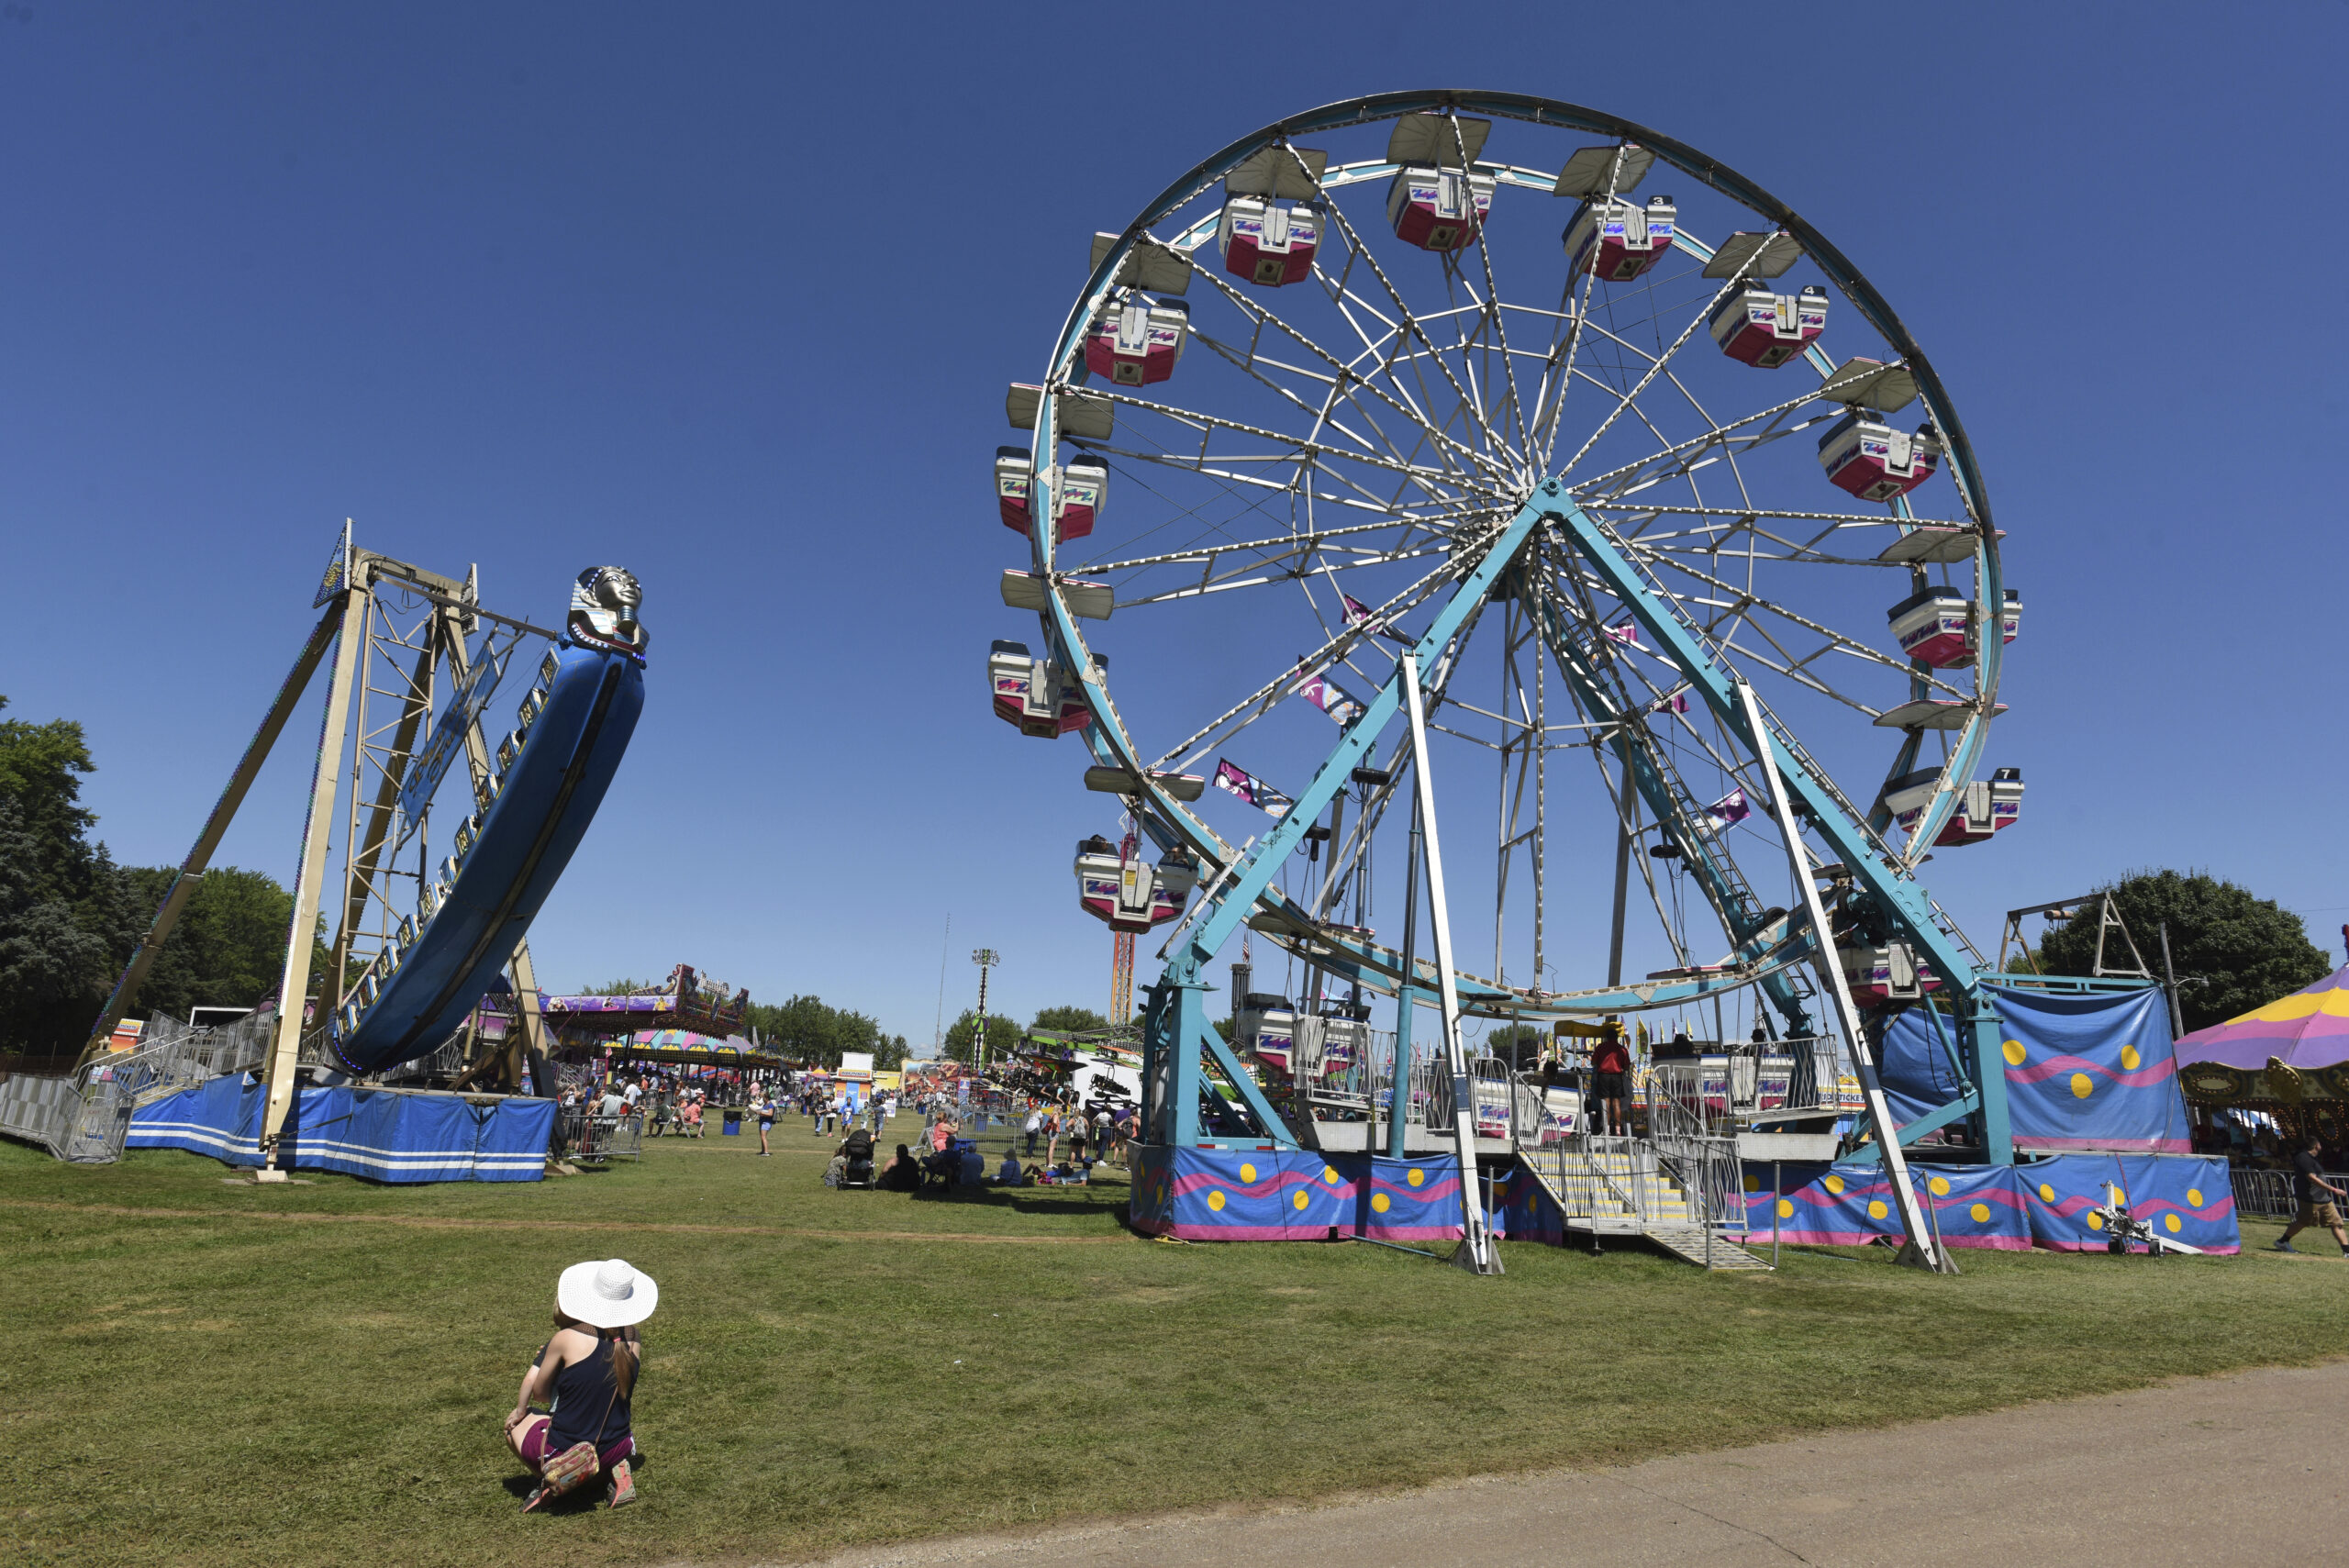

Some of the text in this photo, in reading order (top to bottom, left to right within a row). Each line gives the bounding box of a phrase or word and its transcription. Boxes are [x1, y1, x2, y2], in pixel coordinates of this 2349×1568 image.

[1653, 196, 1664, 206] 3
[1804, 286, 1815, 295] 4
[2001, 769, 2010, 779] 7
